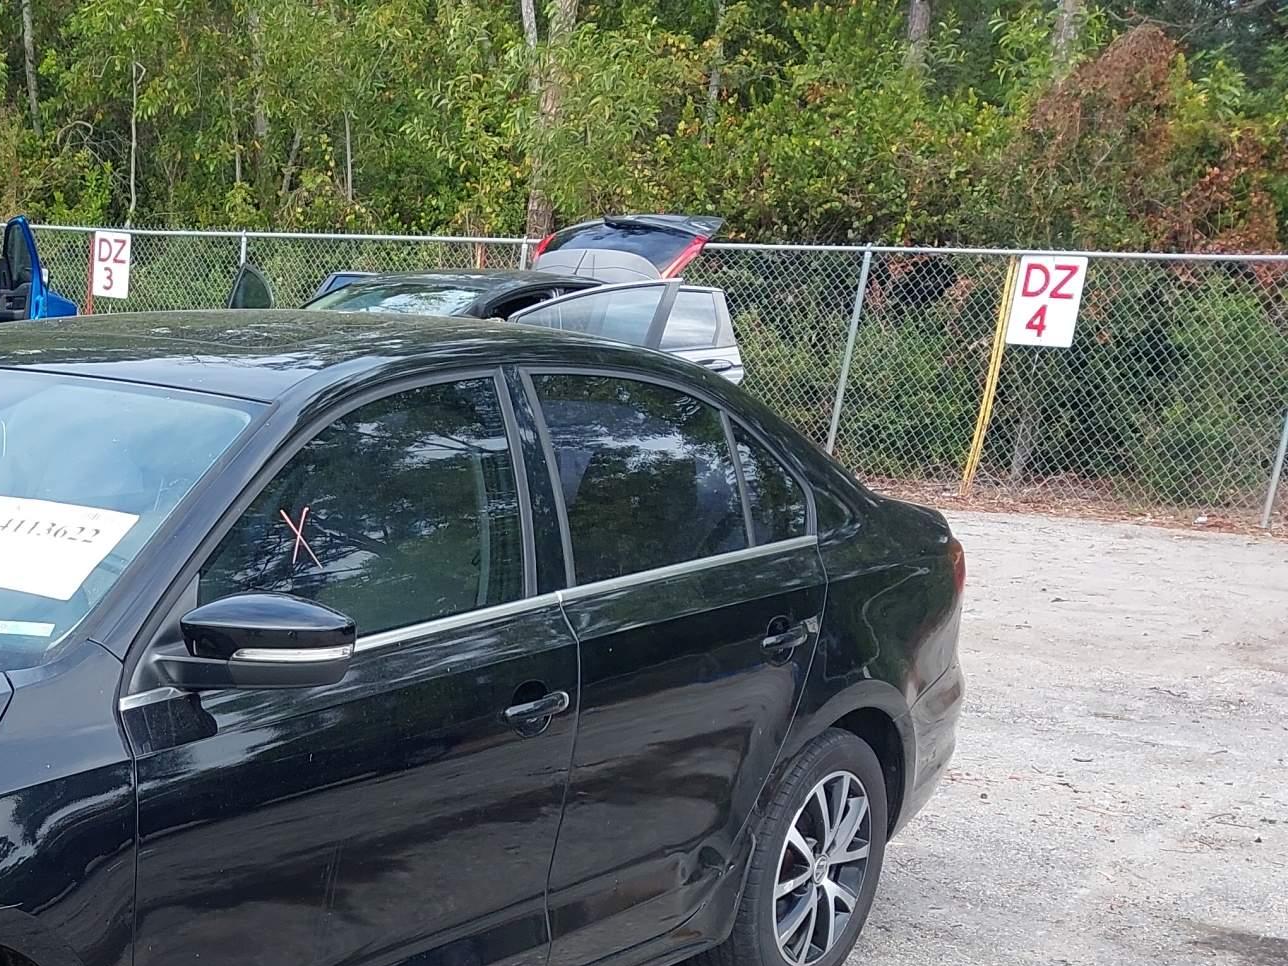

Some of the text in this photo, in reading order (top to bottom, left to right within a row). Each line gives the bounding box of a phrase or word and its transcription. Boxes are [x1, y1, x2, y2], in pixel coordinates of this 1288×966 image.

[98, 238, 127, 264] DZ
[102, 266, 113, 290] 3
[1021, 263, 1079, 299] DZ
[1025, 304, 1048, 337] 4
